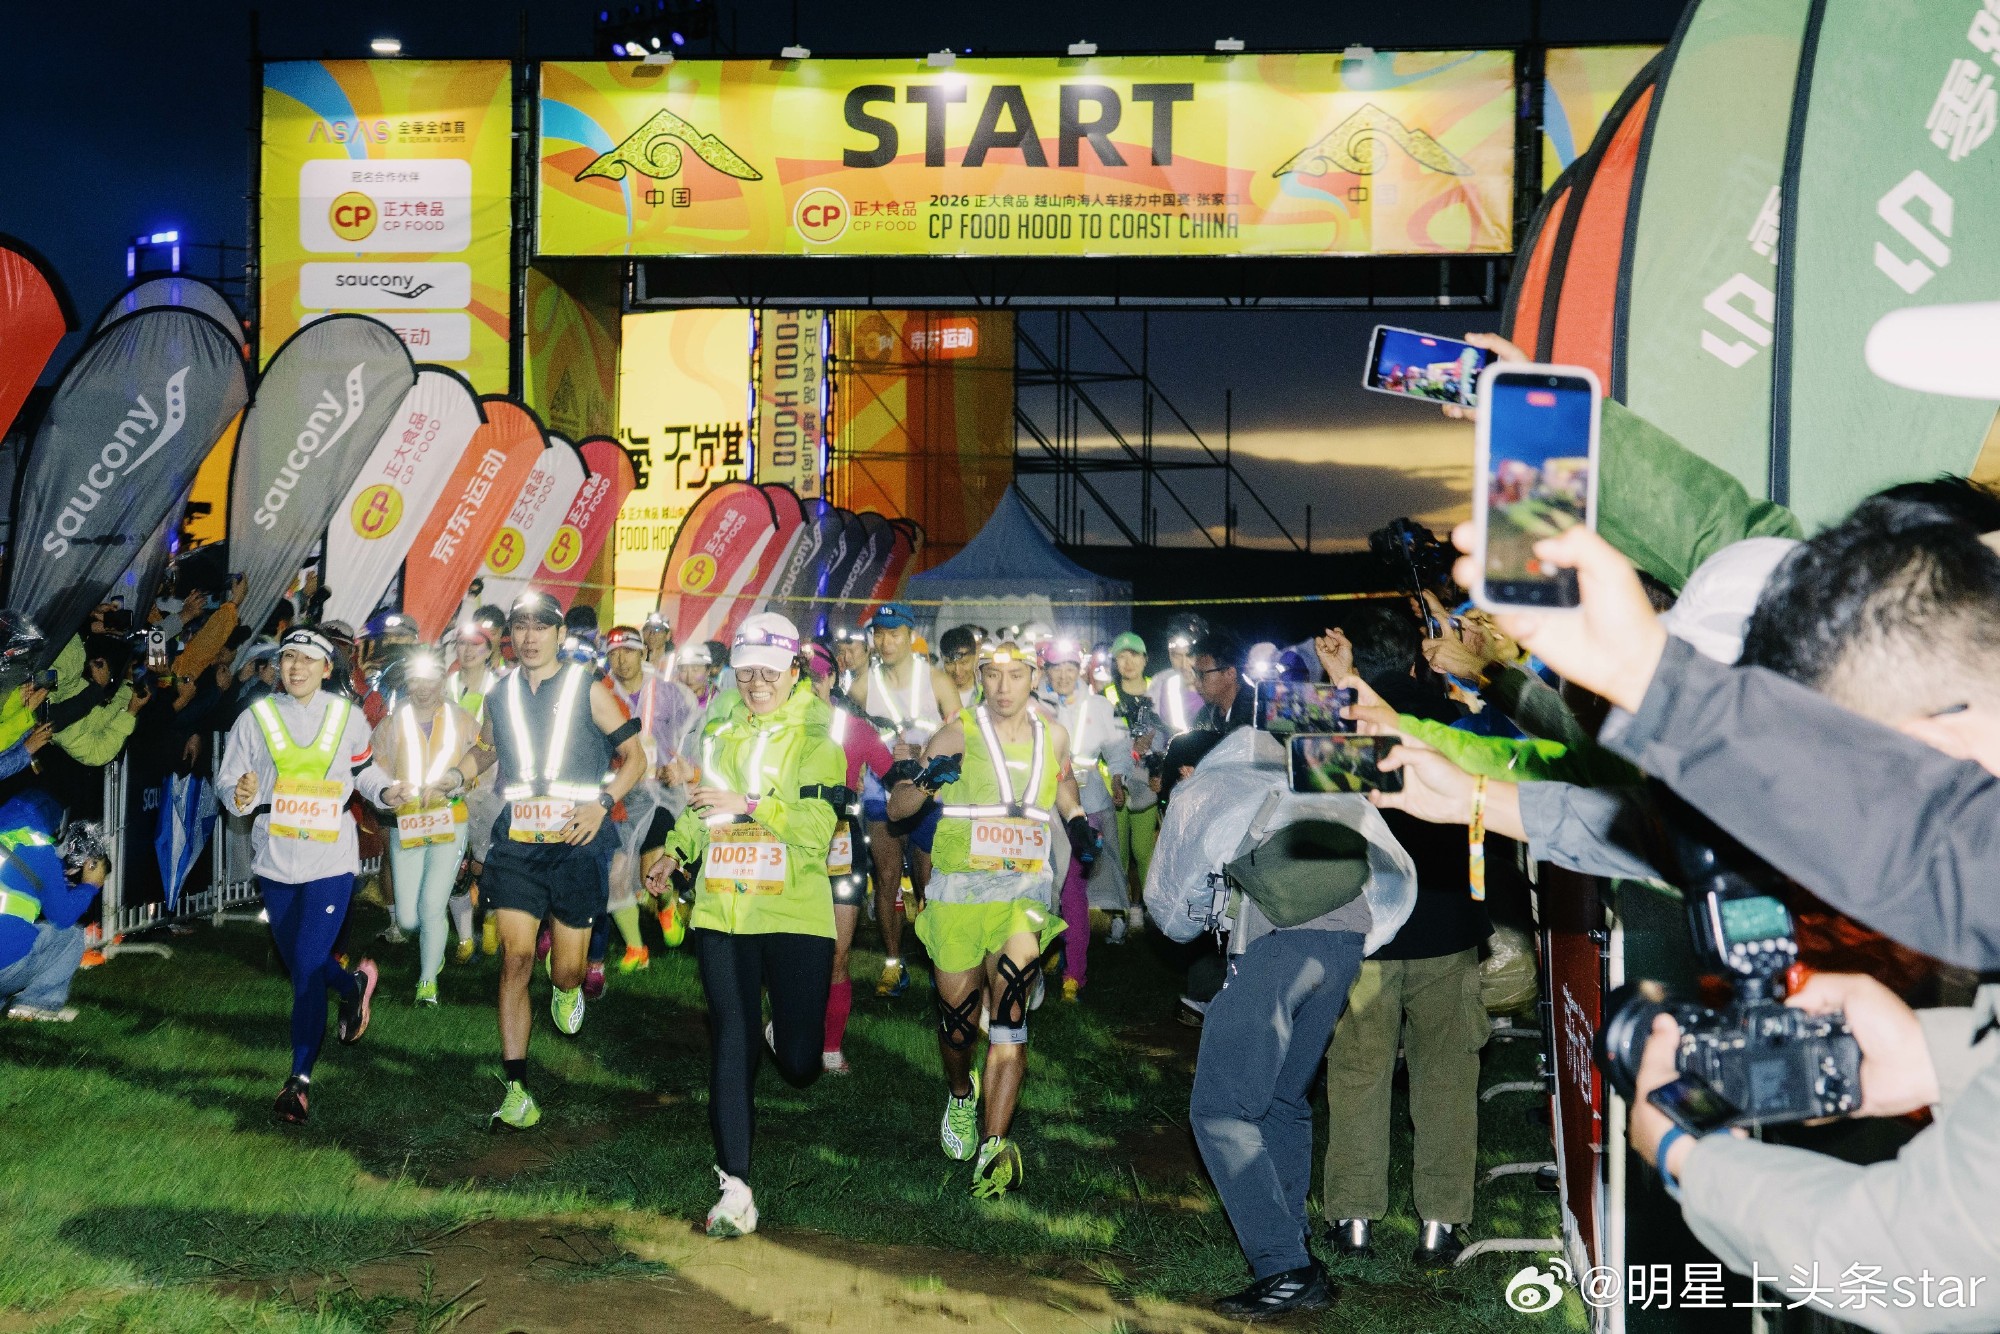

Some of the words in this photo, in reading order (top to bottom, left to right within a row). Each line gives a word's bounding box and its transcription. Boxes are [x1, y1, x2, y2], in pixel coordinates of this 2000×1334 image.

[308, 120, 390, 144] ASAS
[843, 83, 1194, 168] START
[352, 171, 420, 183] 冠名合作伙伴
[384, 201, 444, 217] 正大食品
[645, 187, 691, 208] 中国
[853, 201, 917, 217] 正大食品
[930, 194, 969, 207] 2026
[975, 193, 1029, 208] 正大食品
[335, 205, 371, 227] CP
[383, 220, 401, 231] CP
[405, 220, 444, 231] FOOD
[802, 205, 841, 227] CP
[853, 220, 873, 232] CP
[879, 220, 917, 231] FOOD
[929, 213, 953, 239] CP
[960, 213, 1010, 239] FOOD
[1018, 213, 1072, 239] HOOD
[1079, 213, 1101, 239] TO
[1110, 213, 1172, 239] COAST
[1179, 212, 1239, 239] CHINA
[335, 273, 414, 289] saucony
[776, 309, 800, 380] FOOD
[803, 326, 817, 404] 正大食品
[383, 411, 428, 480] 正大食品
[773, 390, 798, 467] HOOD
[254, 390, 343, 530] saucony
[400, 463, 416, 485] CP
[413, 419, 441, 464] FOOD
[801, 411, 816, 493] 越山向海
[43, 394, 160, 559] saucony
[361, 491, 390, 532] CP
[429, 448, 507, 565] 京东运动
[511, 469, 546, 525] 正大食品
[523, 510, 535, 530] CP
[533, 476, 556, 512] FOOD
[567, 471, 601, 525] 正大食品
[578, 510, 591, 530] CP
[589, 477, 612, 512] FOOD
[551, 531, 571, 565] CP
[620, 526, 648, 551] FOOD
[652, 526, 677, 551] HOO
[704, 508, 738, 554] 正大食品
[714, 542, 726, 557] CP
[724, 515, 747, 544] FOOD
[491, 533, 516, 568] CP
[686, 560, 706, 587] CP
[777, 534, 814, 606] saucony
[836, 547, 869, 610] saucony
[275, 798, 338, 818] 0046-1
[400, 815, 450, 831] 0033-3
[513, 804, 573, 820] 0014-2
[976, 825, 1044, 846] 0001-5
[711, 846, 782, 866] 0003-3
